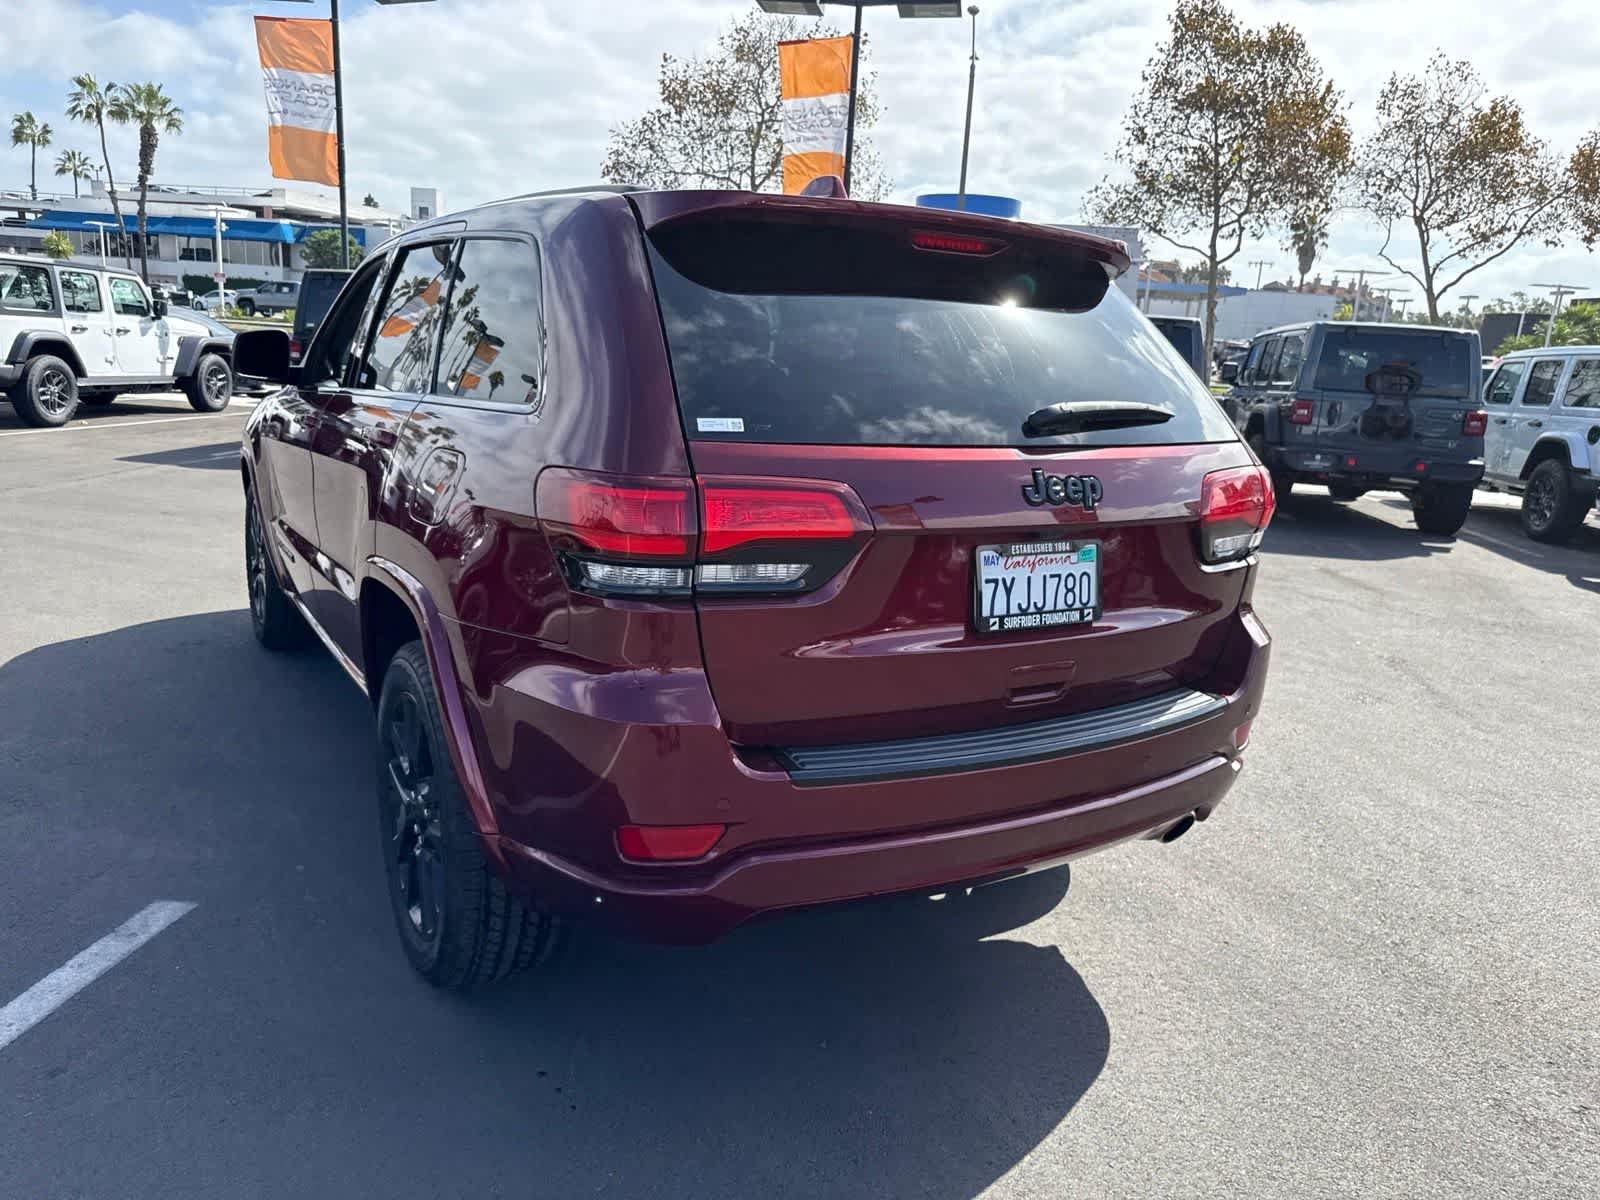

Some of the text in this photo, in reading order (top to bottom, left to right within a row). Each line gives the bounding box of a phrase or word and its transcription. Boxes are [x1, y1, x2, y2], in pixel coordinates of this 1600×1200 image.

[1022, 468, 1103, 511] Jeep
[1011, 543, 1053, 555] ESTABLISHED
[983, 554, 1000, 567] MAY
[1003, 553, 1078, 573] California
[984, 571, 1091, 617] 7YJJ780
[1004, 611, 1080, 629] SURFRIDER FOUNDATION
